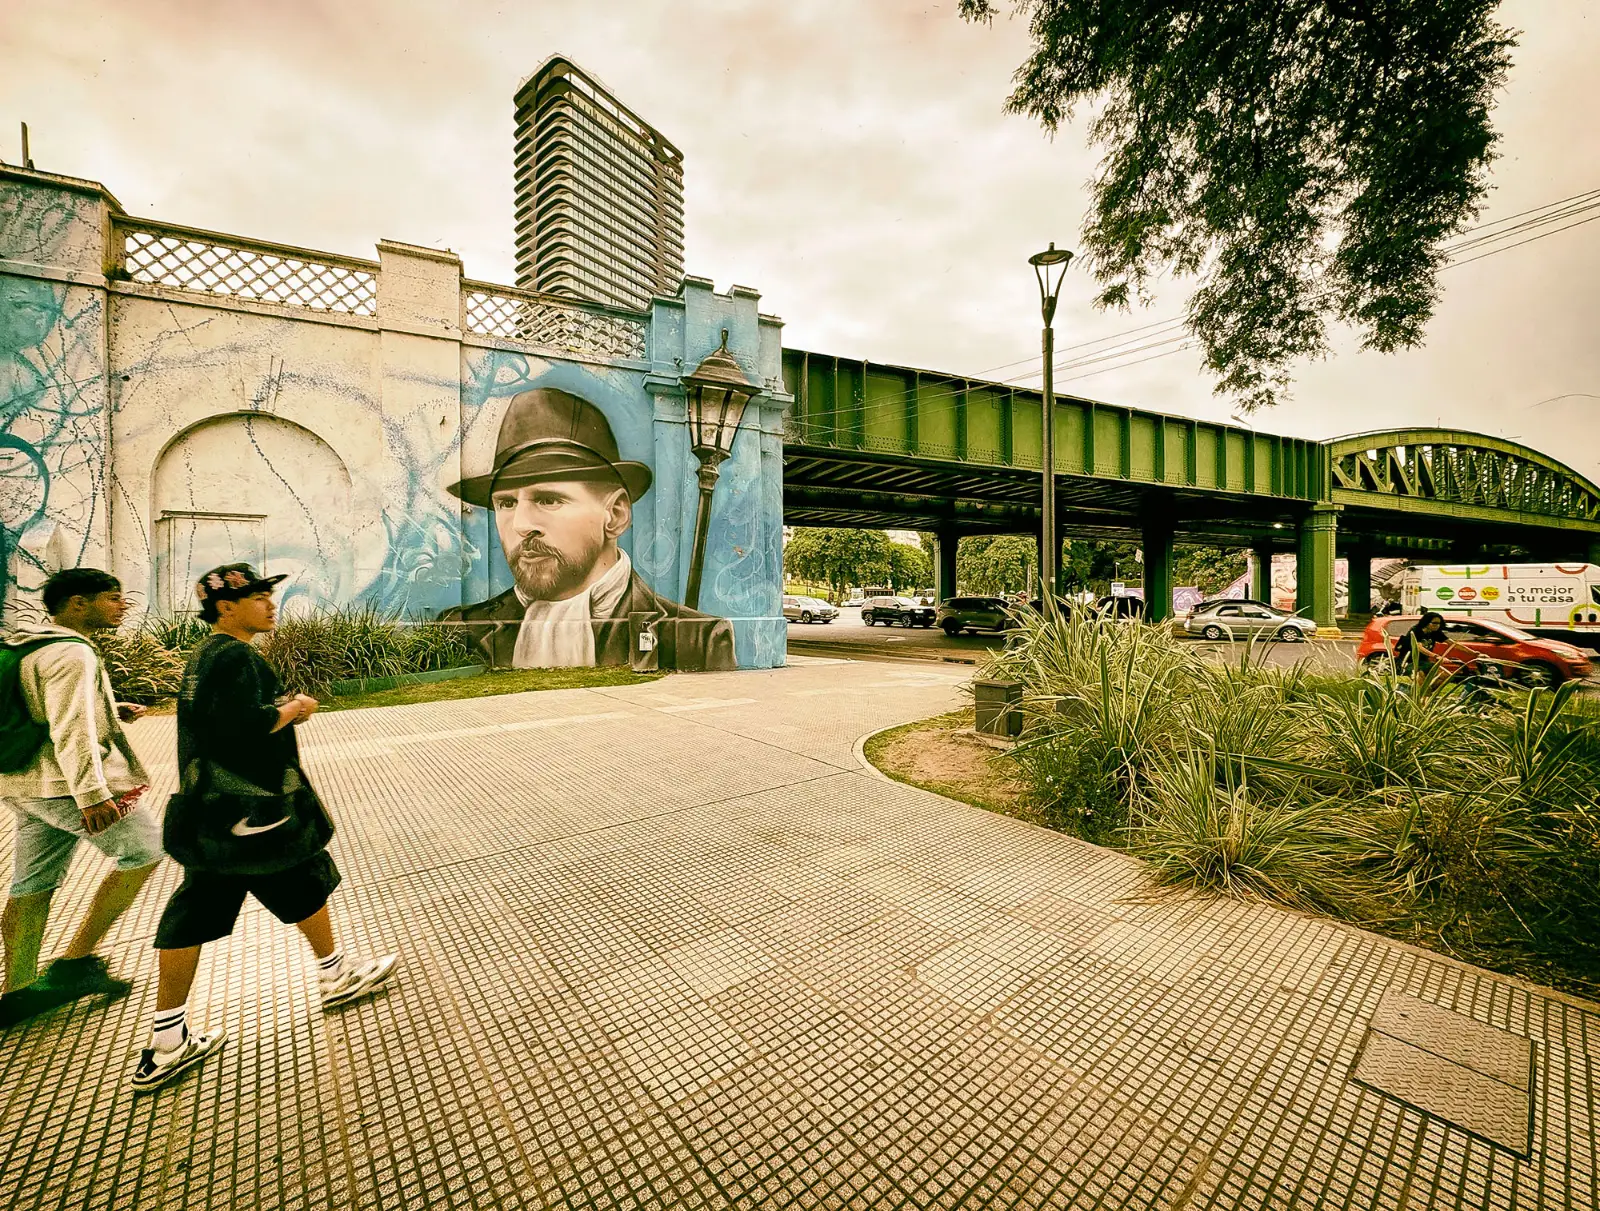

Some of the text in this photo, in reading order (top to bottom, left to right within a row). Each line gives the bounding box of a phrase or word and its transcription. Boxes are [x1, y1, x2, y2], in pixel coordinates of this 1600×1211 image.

[1508, 585, 1574, 595] Lo mejor
[1520, 595, 1535, 603] tu
[1540, 595, 1574, 603] casa
